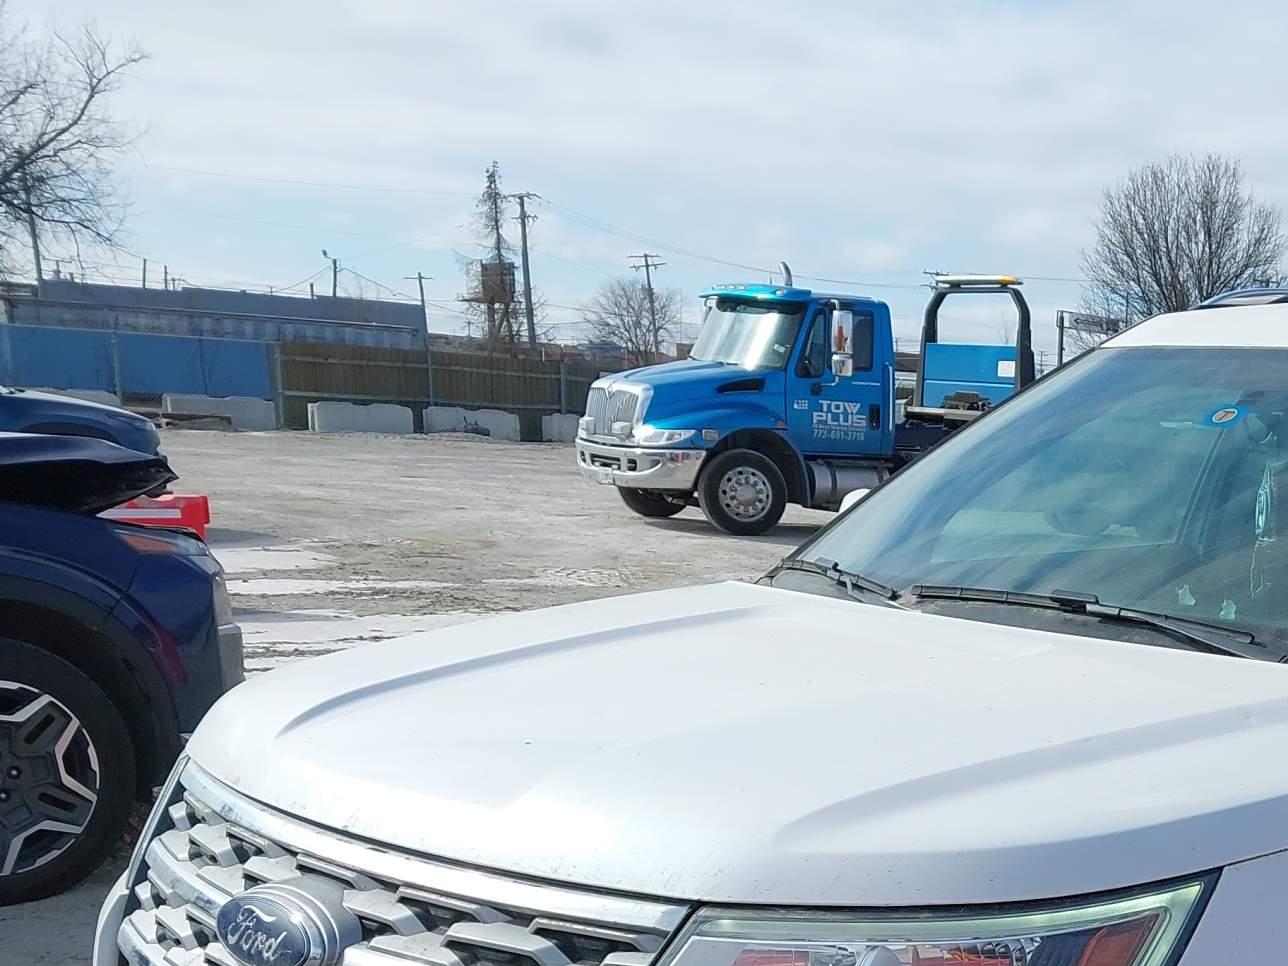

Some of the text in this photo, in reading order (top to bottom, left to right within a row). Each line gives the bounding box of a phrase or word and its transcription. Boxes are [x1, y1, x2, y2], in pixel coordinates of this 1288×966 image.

[819, 400, 861, 414] TOW
[812, 411, 867, 427] PLUS
[226, 904, 288, 961] Ford
